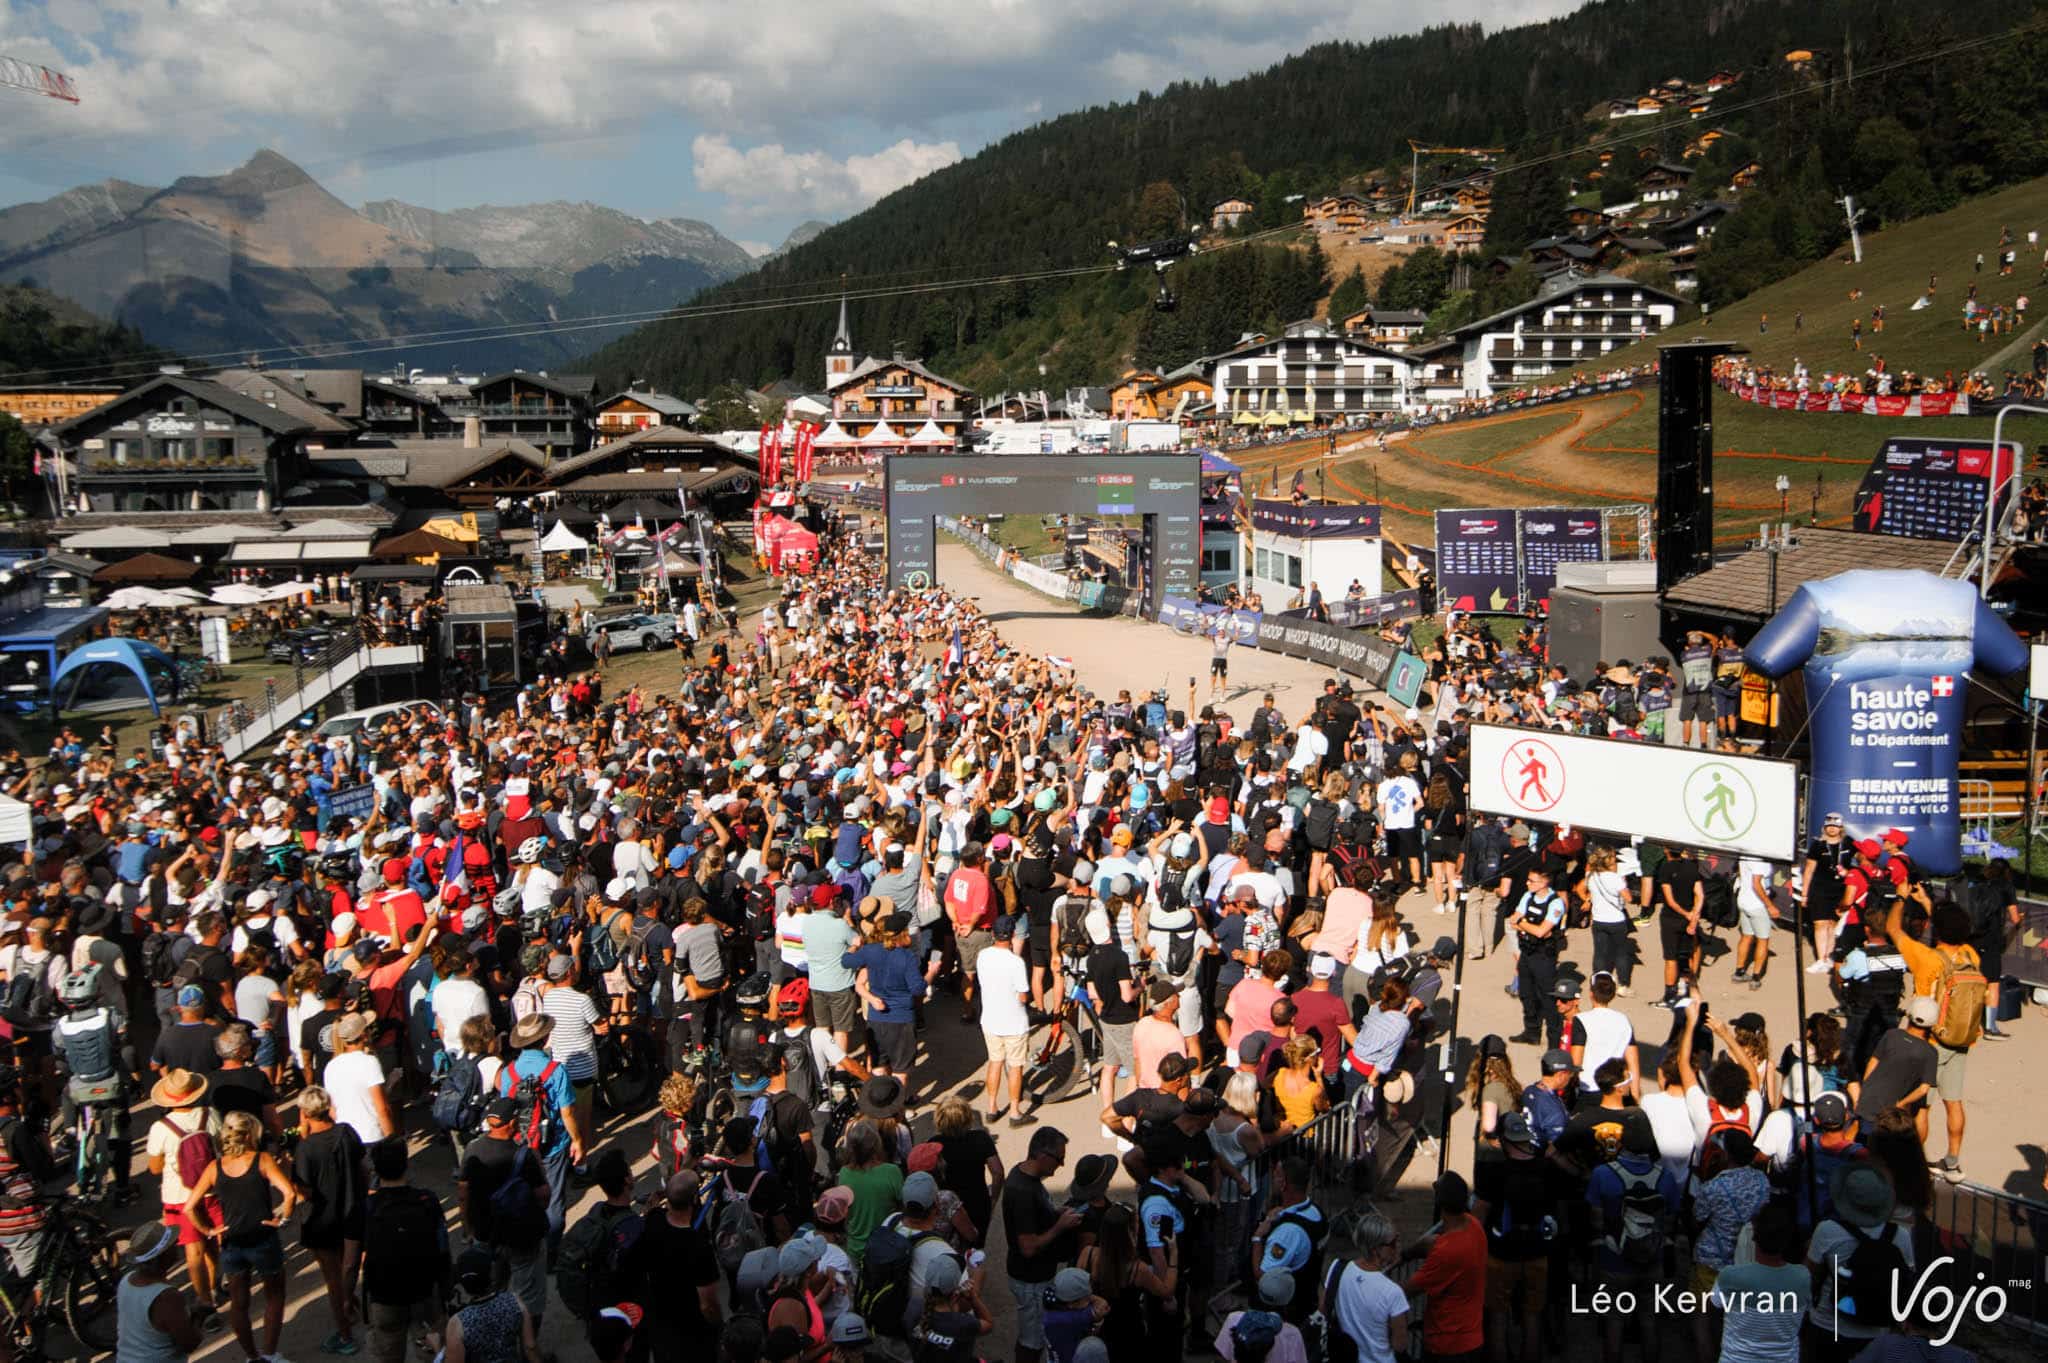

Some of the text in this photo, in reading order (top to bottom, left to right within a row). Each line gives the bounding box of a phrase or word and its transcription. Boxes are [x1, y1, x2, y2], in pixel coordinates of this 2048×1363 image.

[443, 578, 485, 586] NISSAN
[1259, 624, 1284, 640] WHOOP
[1285, 628, 1310, 644] WHOOP
[1309, 632, 1339, 652] WHOOP
[1339, 639, 1367, 662] WHOOP
[1850, 683, 1930, 709] haute
[1851, 710, 1938, 730] savoie
[1850, 733, 1949, 748] le Département
[1849, 779, 1949, 793] BIENVENUE
[1849, 793, 1949, 804] EN HAUTE-SAVOIE
[1849, 804, 1894, 815] TERRE
[1899, 804, 1917, 815] DE
